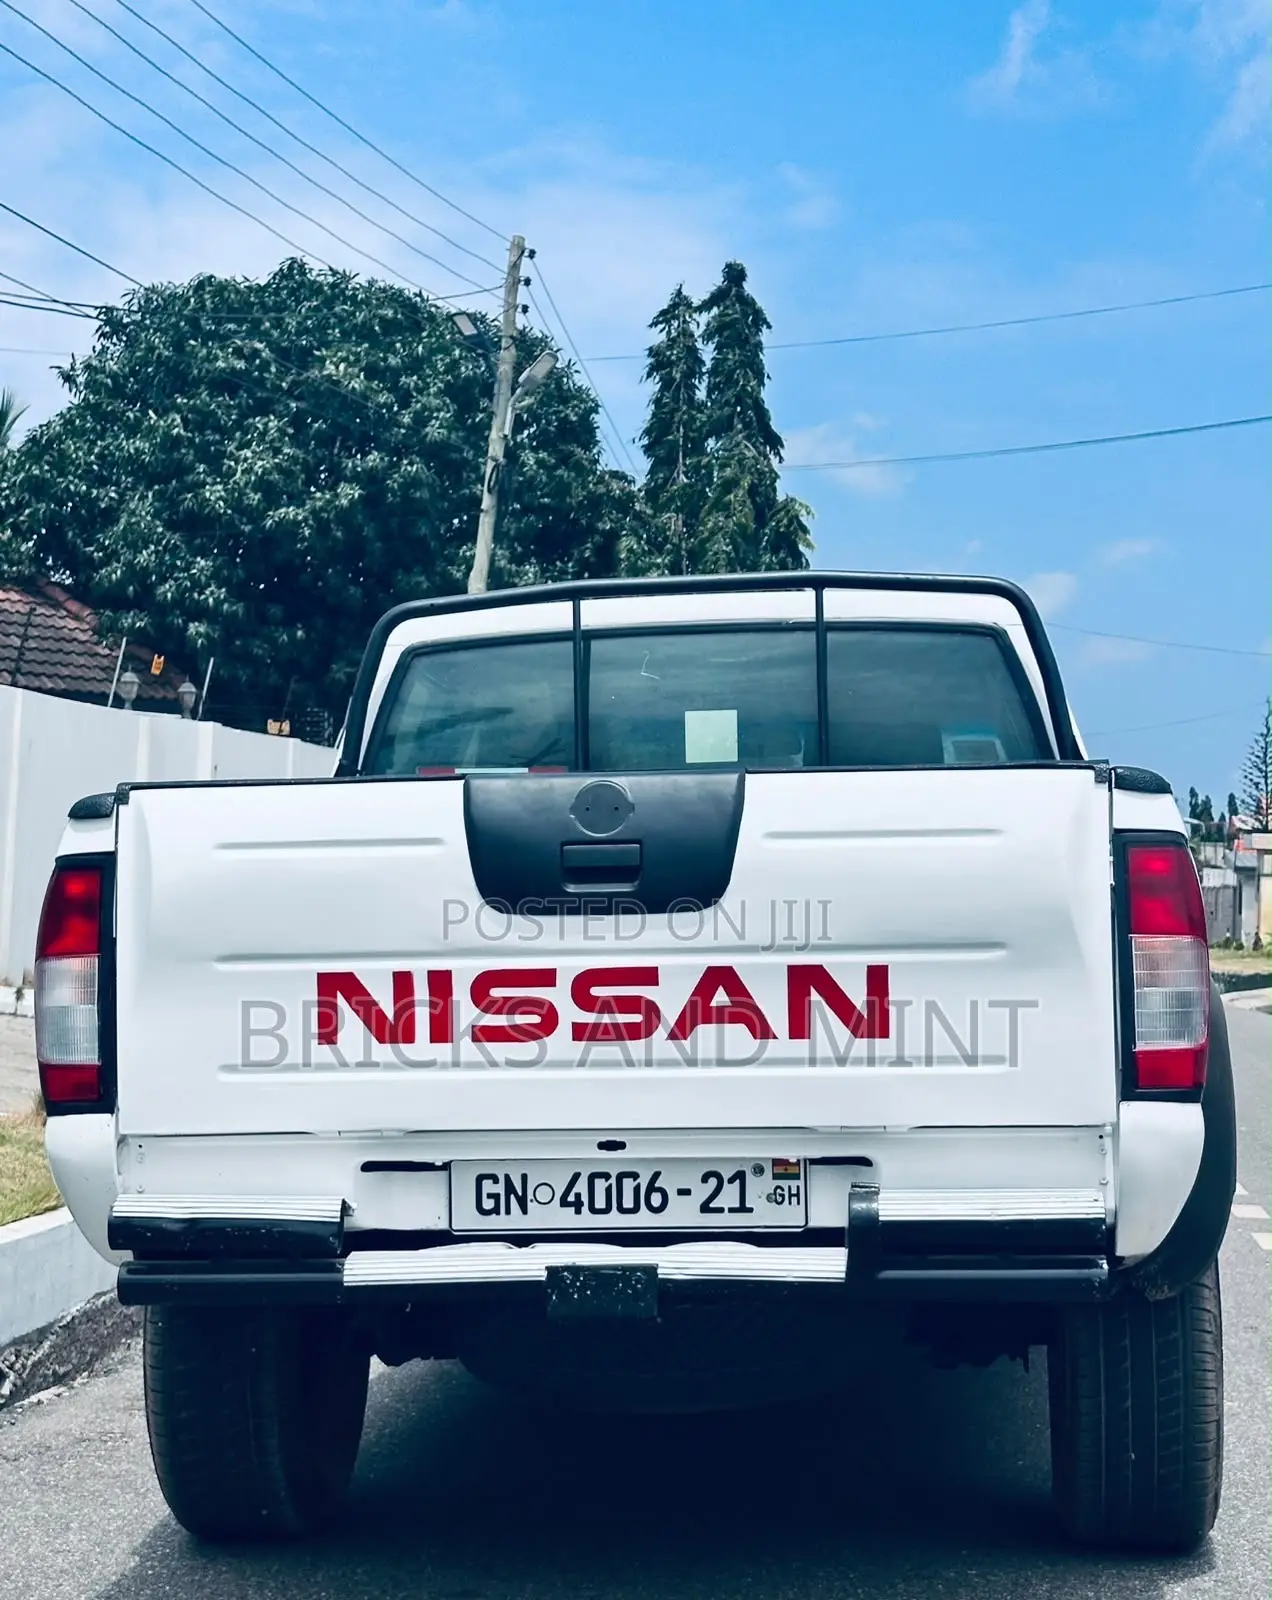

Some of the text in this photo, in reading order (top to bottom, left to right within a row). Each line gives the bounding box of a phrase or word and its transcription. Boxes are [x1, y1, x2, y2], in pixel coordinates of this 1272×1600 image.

[317, 964, 890, 1045] NISSAN
[475, 1173, 528, 1215] GN
[773, 1185, 801, 1206] GH
